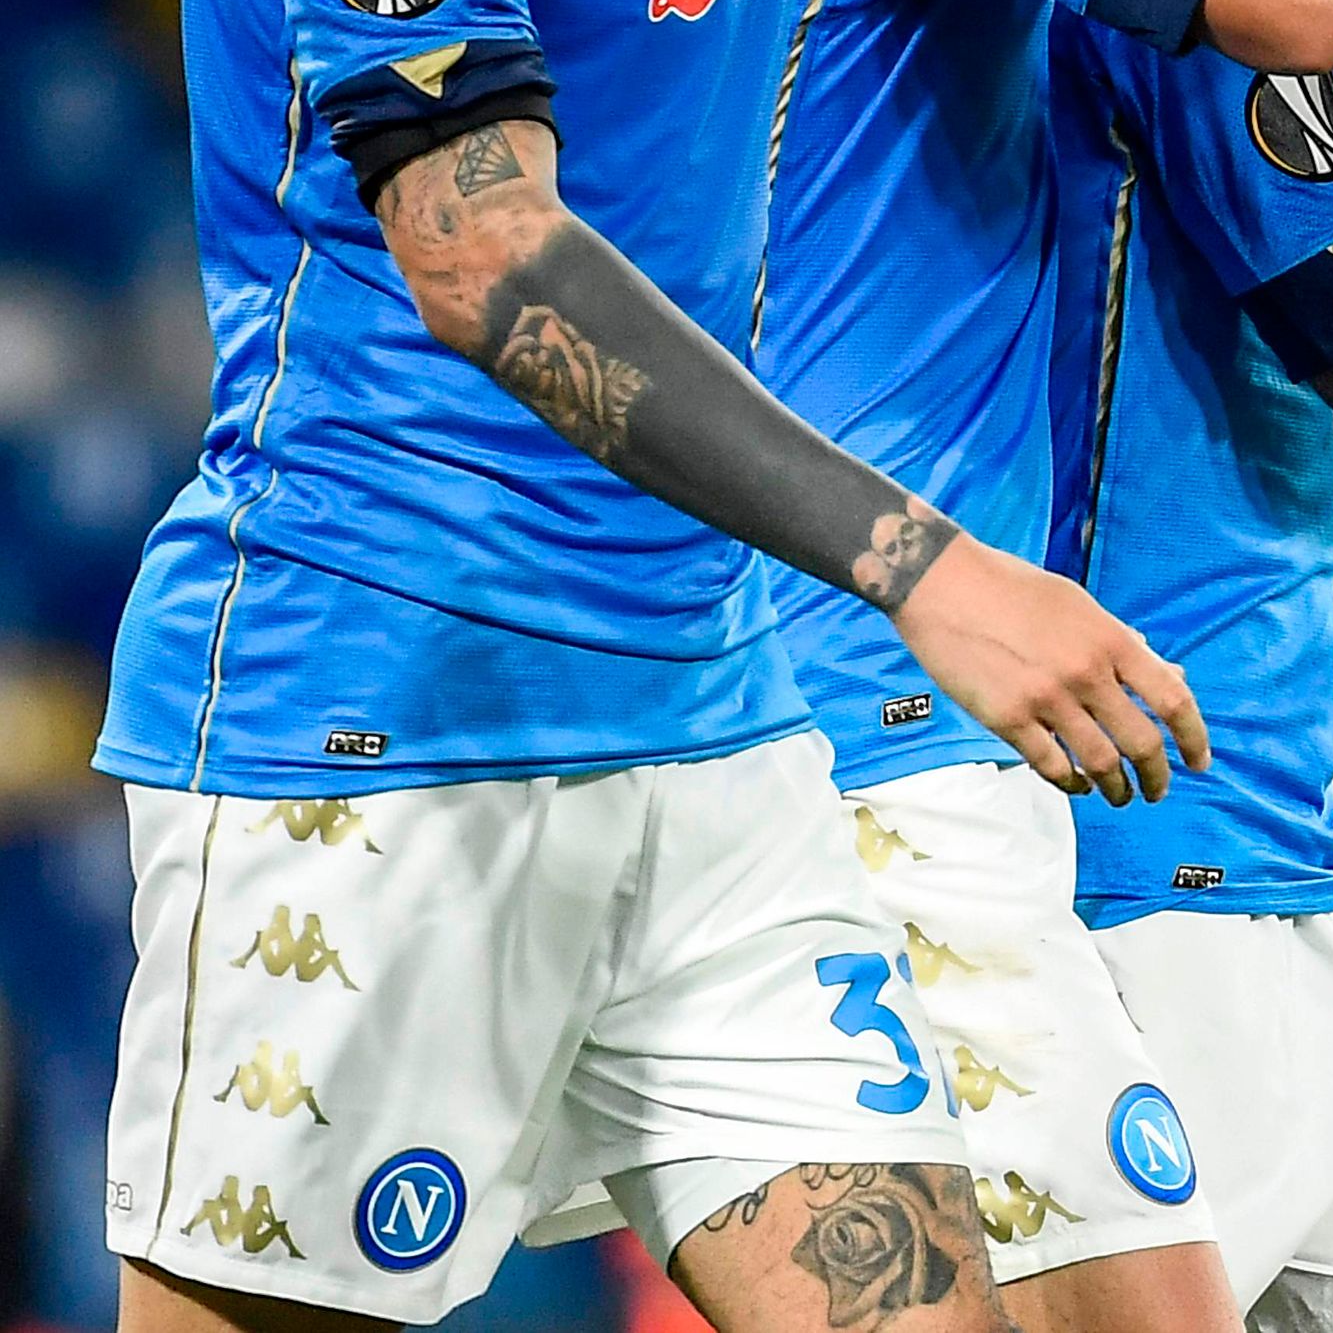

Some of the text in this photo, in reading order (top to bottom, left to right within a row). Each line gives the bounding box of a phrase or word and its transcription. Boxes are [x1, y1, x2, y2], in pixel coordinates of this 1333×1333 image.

[815, 952, 960, 1118] 3
[1135, 1115, 1182, 1173] N
[380, 1179, 445, 1242] N
